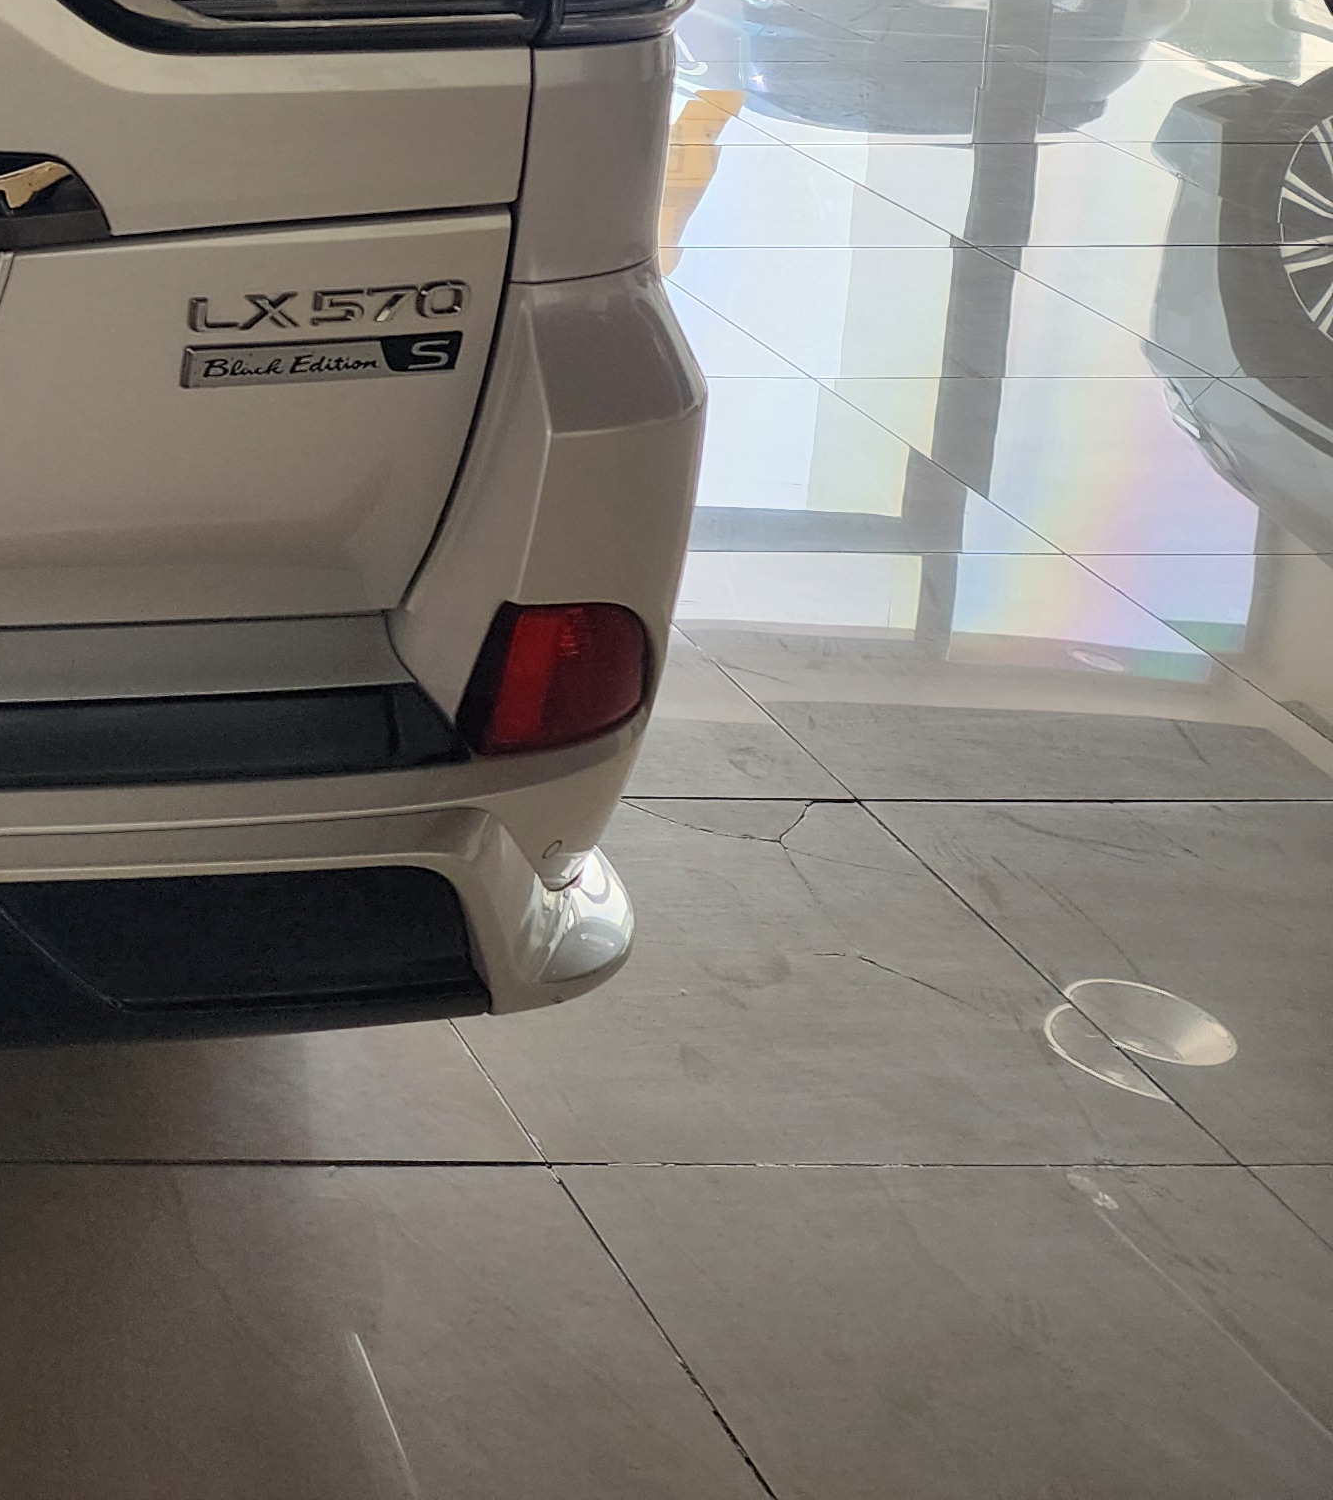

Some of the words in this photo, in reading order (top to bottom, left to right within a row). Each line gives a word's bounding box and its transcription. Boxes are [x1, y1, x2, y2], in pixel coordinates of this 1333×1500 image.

[187, 291, 300, 332] LX
[310, 278, 471, 326] 570
[202, 358, 284, 378] Black
[289, 353, 380, 374] Edition
[407, 339, 452, 370] S
